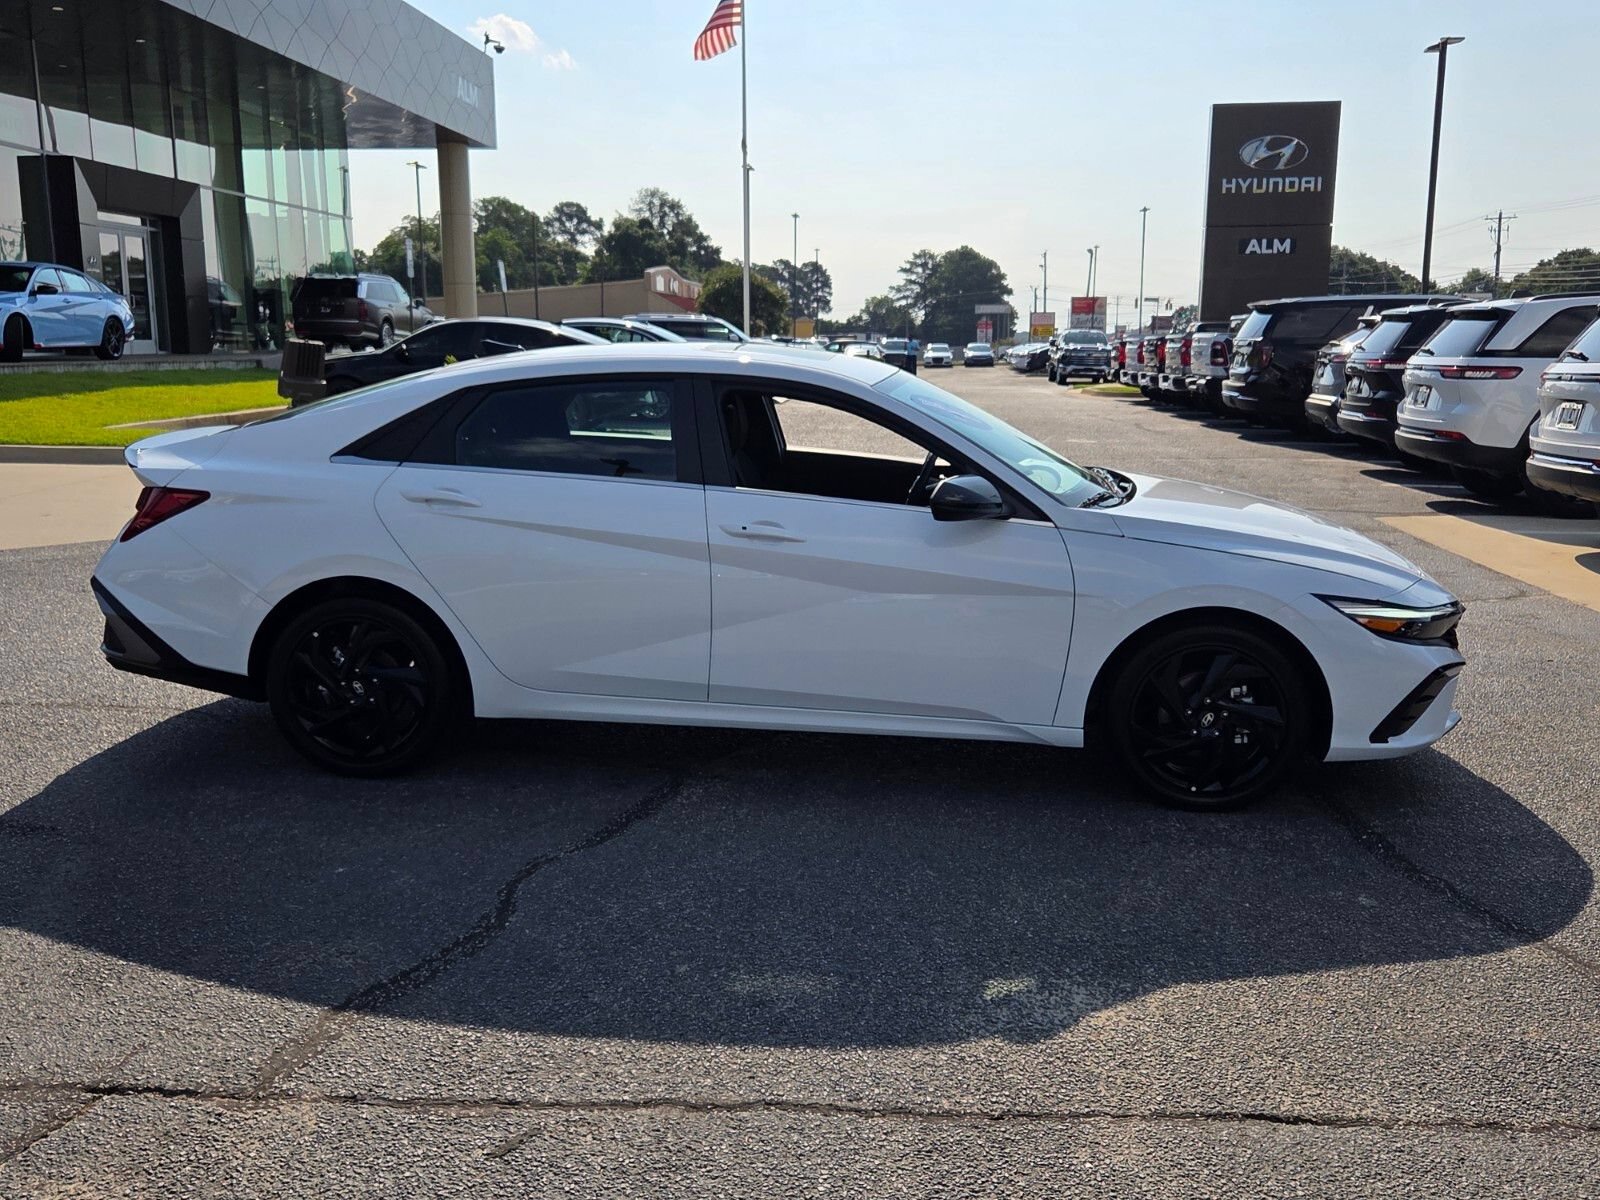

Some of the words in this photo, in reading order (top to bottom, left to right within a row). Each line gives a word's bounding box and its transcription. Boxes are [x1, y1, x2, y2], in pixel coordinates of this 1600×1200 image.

[457, 76, 479, 108] ALM
[1222, 176, 1322, 194] HYUNDAI
[1245, 238, 1292, 254] ALM
